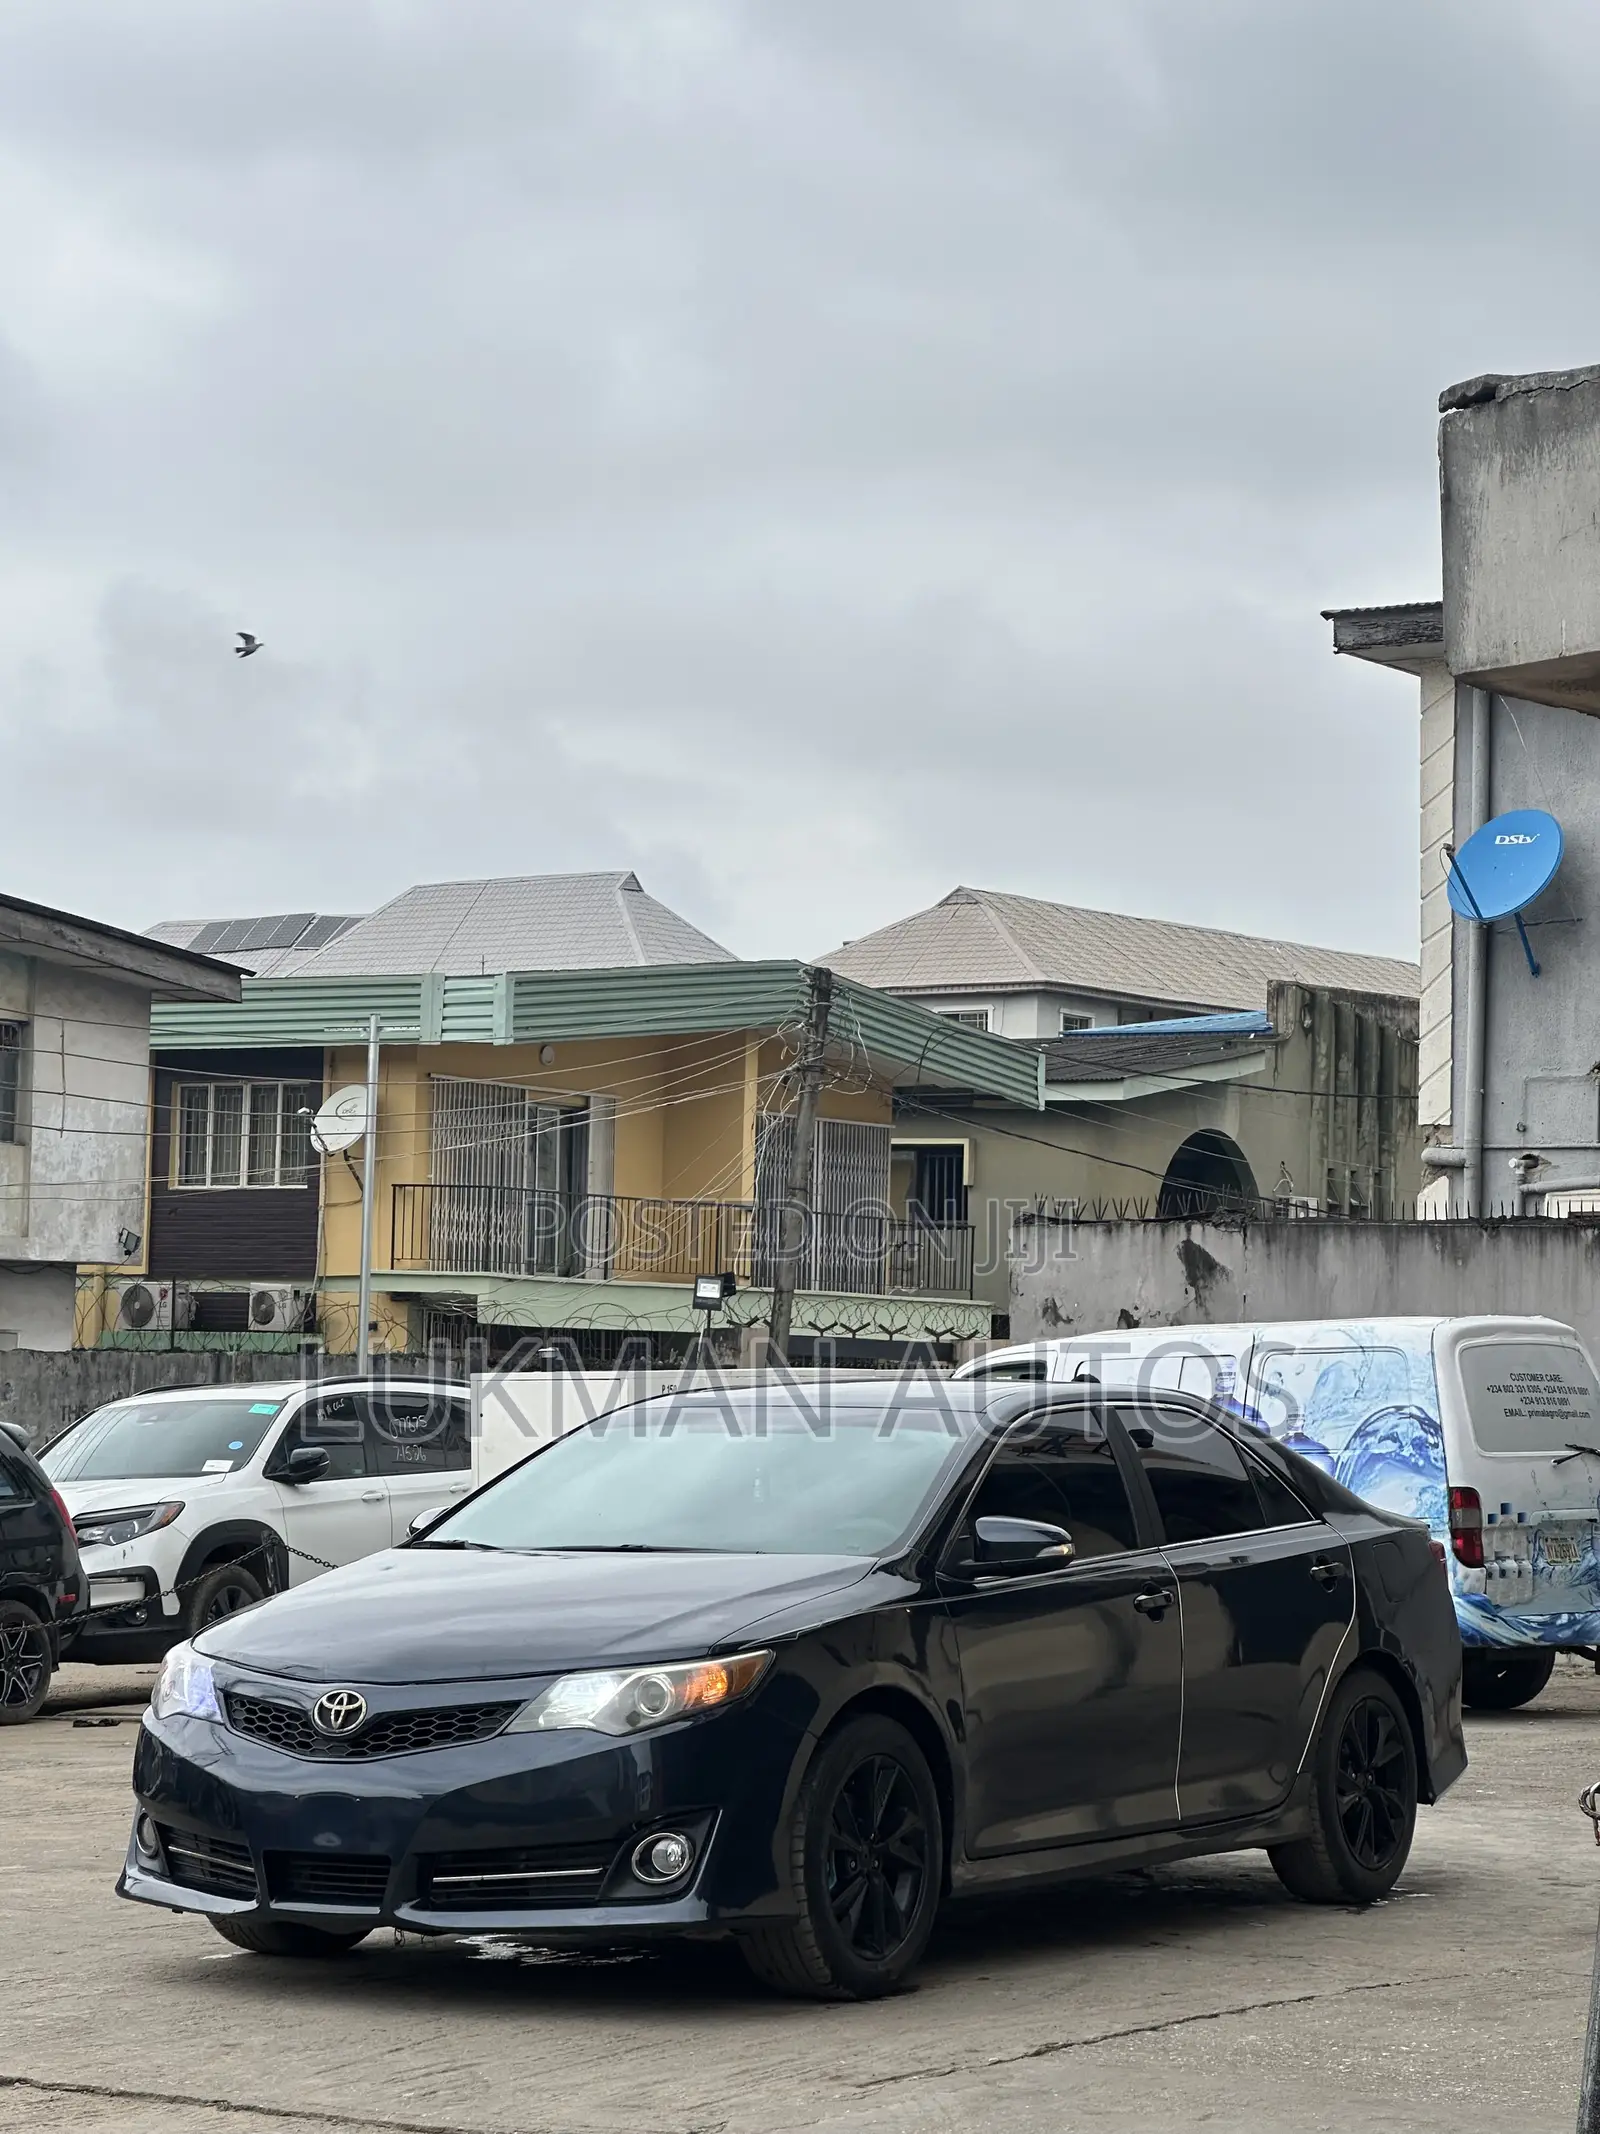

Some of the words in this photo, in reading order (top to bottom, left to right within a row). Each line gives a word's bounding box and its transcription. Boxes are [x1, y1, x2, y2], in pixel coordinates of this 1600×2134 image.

[1495, 833, 1540, 845] DStv
[159, 1301, 167, 1309] LG
[1509, 1373, 1545, 1383] CUSTOMER
